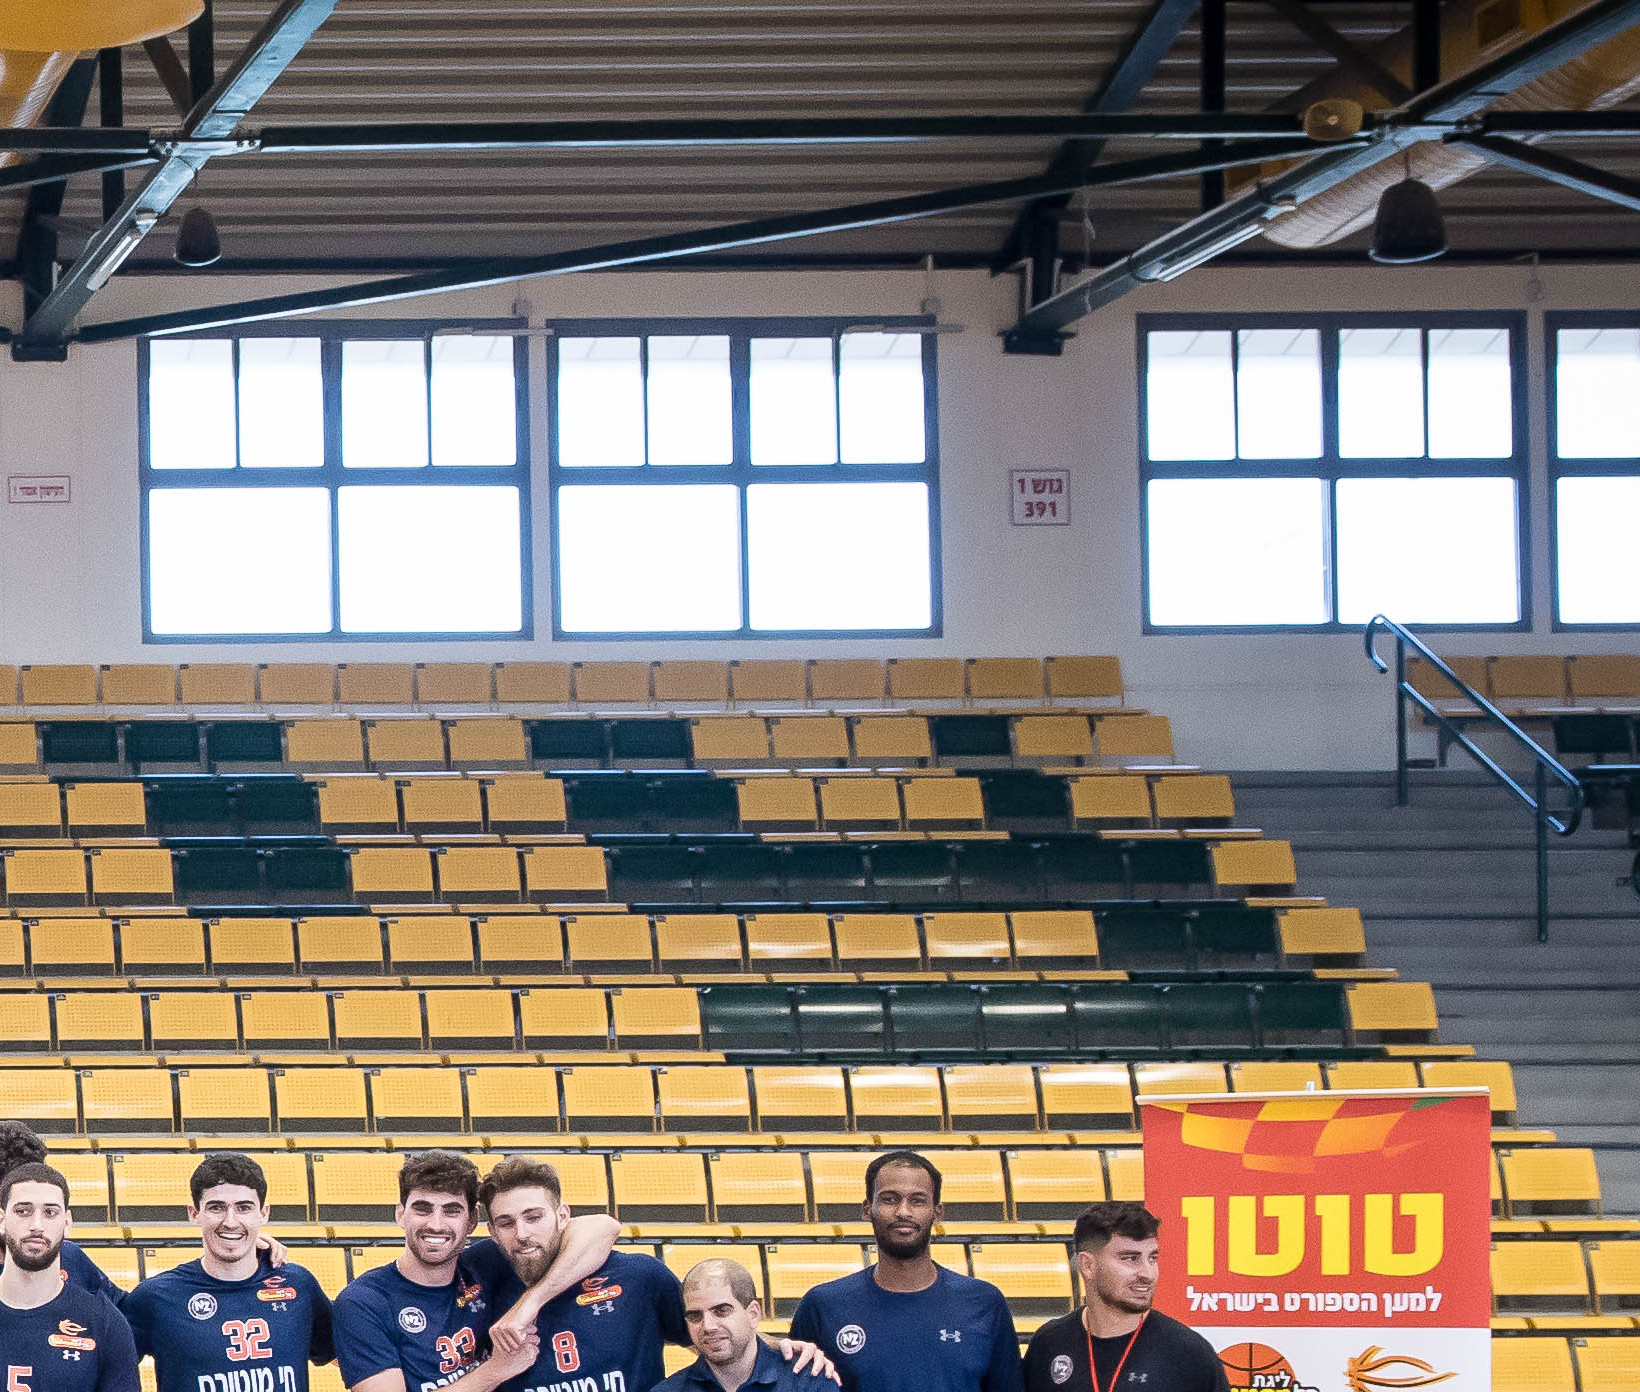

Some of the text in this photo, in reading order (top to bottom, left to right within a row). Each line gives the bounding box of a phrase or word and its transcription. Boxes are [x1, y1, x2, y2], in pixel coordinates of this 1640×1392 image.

[1024, 501, 1057, 519] 391
[1181, 1192, 1445, 1278] טוטו
[1186, 1286, 1442, 1318] למען הספורט בישראל
[221, 1317, 273, 1362] 32
[552, 1330, 580, 1374] 8
[842, 1332, 860, 1347] NZ
[1252, 1370, 1291, 1388] ליגת
